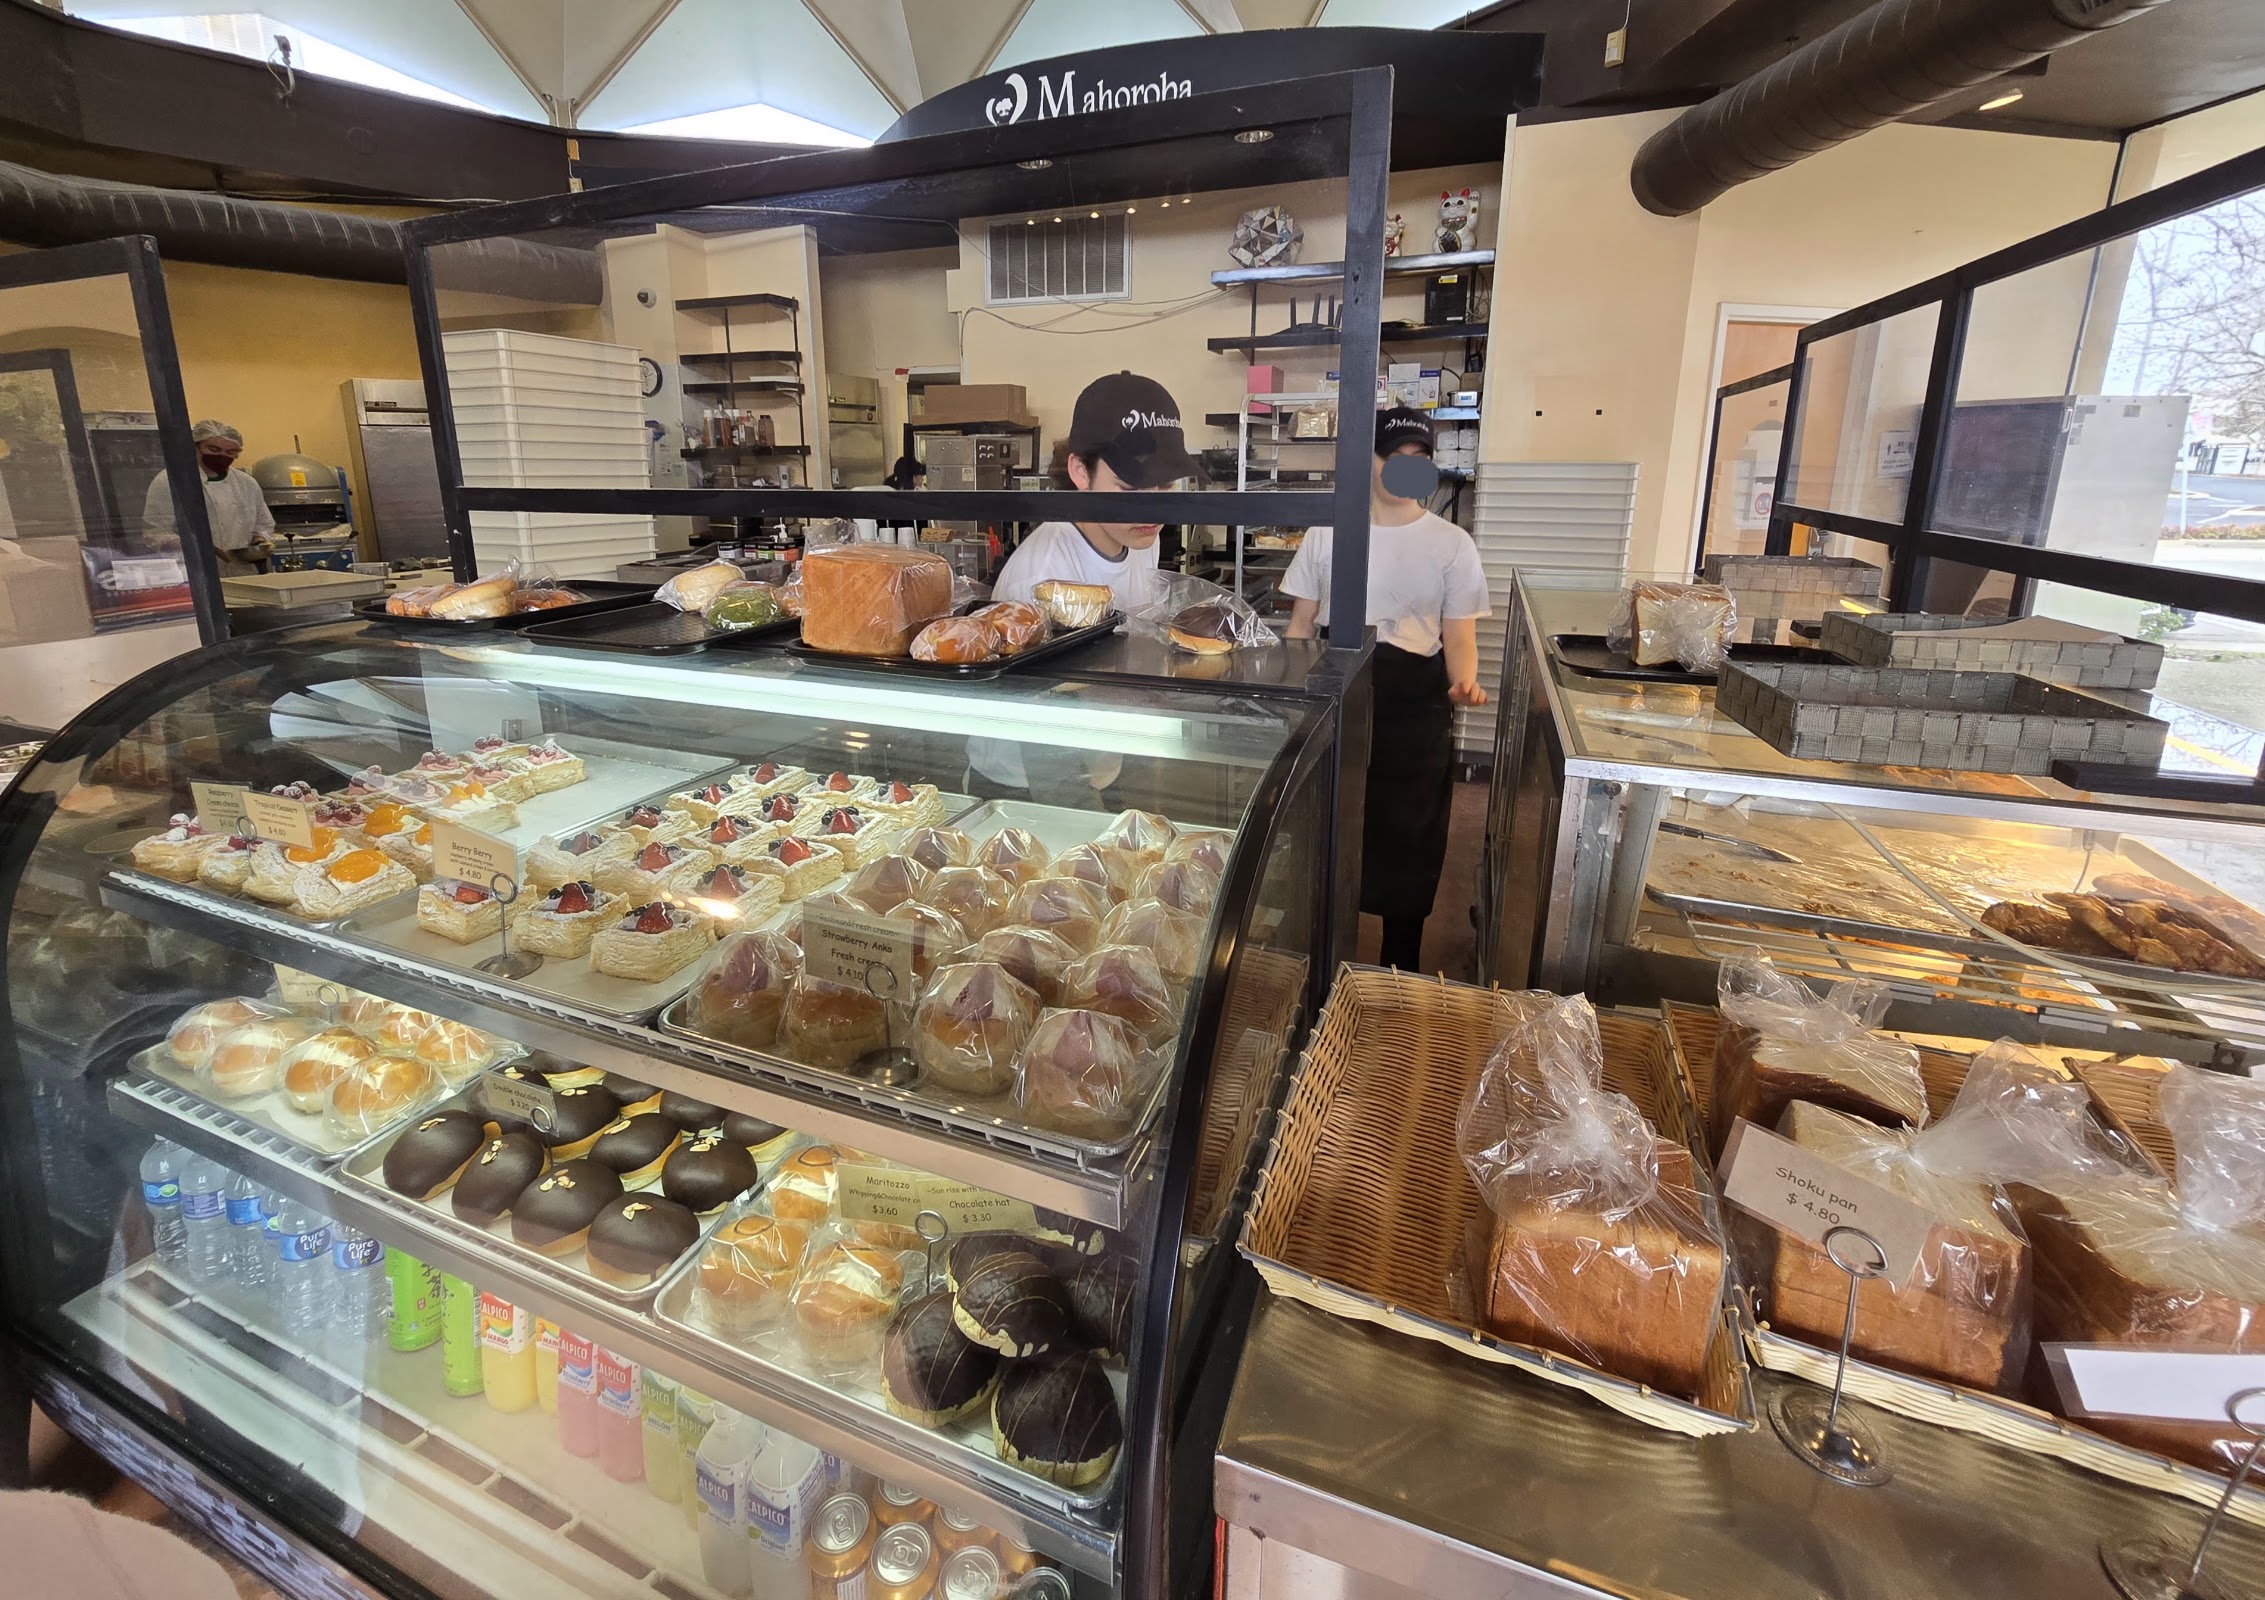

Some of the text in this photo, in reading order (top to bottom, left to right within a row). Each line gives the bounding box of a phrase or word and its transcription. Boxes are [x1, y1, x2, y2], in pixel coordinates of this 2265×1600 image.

[1037, 70, 1193, 121] Mahoroba
[254, 799, 298, 814] Tropical Dessert
[451, 842, 493, 861] Berry Berry
[459, 867, 464, 876] $
[465, 869, 482, 880] 4.80
[821, 929, 893, 953] Strawberry Anko
[831, 948, 855, 961] Fresh
[837, 966, 864, 980] $ 4.10
[866, 1175, 910, 1190] Maritozzo
[961, 1185, 978, 1193] with
[1775, 1166, 1858, 1213] Shoku pan
[872, 1204, 898, 1216] $3.60
[949, 1198, 1011, 1209] Chocolate hat
[1785, 1191, 1840, 1225] $ 4.80
[962, 1213, 992, 1224] $ 3.30
[300, 1228, 325, 1244] Pure
[303, 1237, 323, 1251] Life
[348, 1239, 374, 1252] Pure
[350, 1247, 372, 1260] Life
[487, 1333, 509, 1345] MANGO
[542, 1336, 559, 1347] MAN
[642, 1382, 670, 1406] ALPICO
